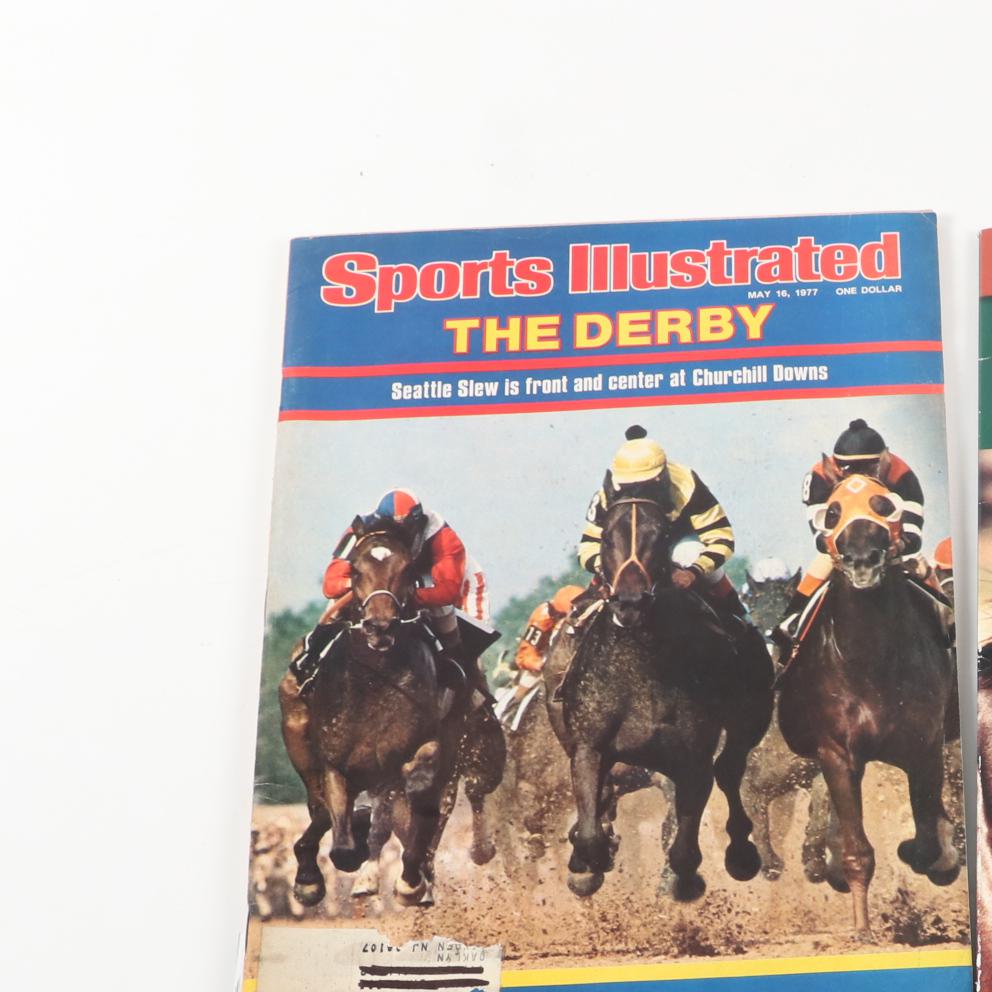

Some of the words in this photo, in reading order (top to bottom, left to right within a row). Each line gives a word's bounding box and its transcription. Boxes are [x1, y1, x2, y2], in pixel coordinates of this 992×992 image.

[320, 250, 554, 313] Sports
[569, 232, 901, 293] Illustrated
[748, 290, 771, 299] MAY
[776, 289, 790, 298] 16,
[795, 288, 818, 297] 1977
[836, 287, 857, 296] ONE
[861, 285, 902, 294] DOLLAR
[443, 314, 561, 354] THE
[573, 303, 775, 349] DERBY
[391, 381, 452, 400] Seattle
[458, 379, 499, 397] Slew
[504, 379, 519, 396] is
[526, 376, 568, 395] front
[574, 374, 603, 392] and
[608, 371, 663, 390] center
[670, 369, 686, 387] at
[693, 366, 767, 386] Churchill
[773, 364, 828, 381] Downs
[525, 626, 542, 646] 13
